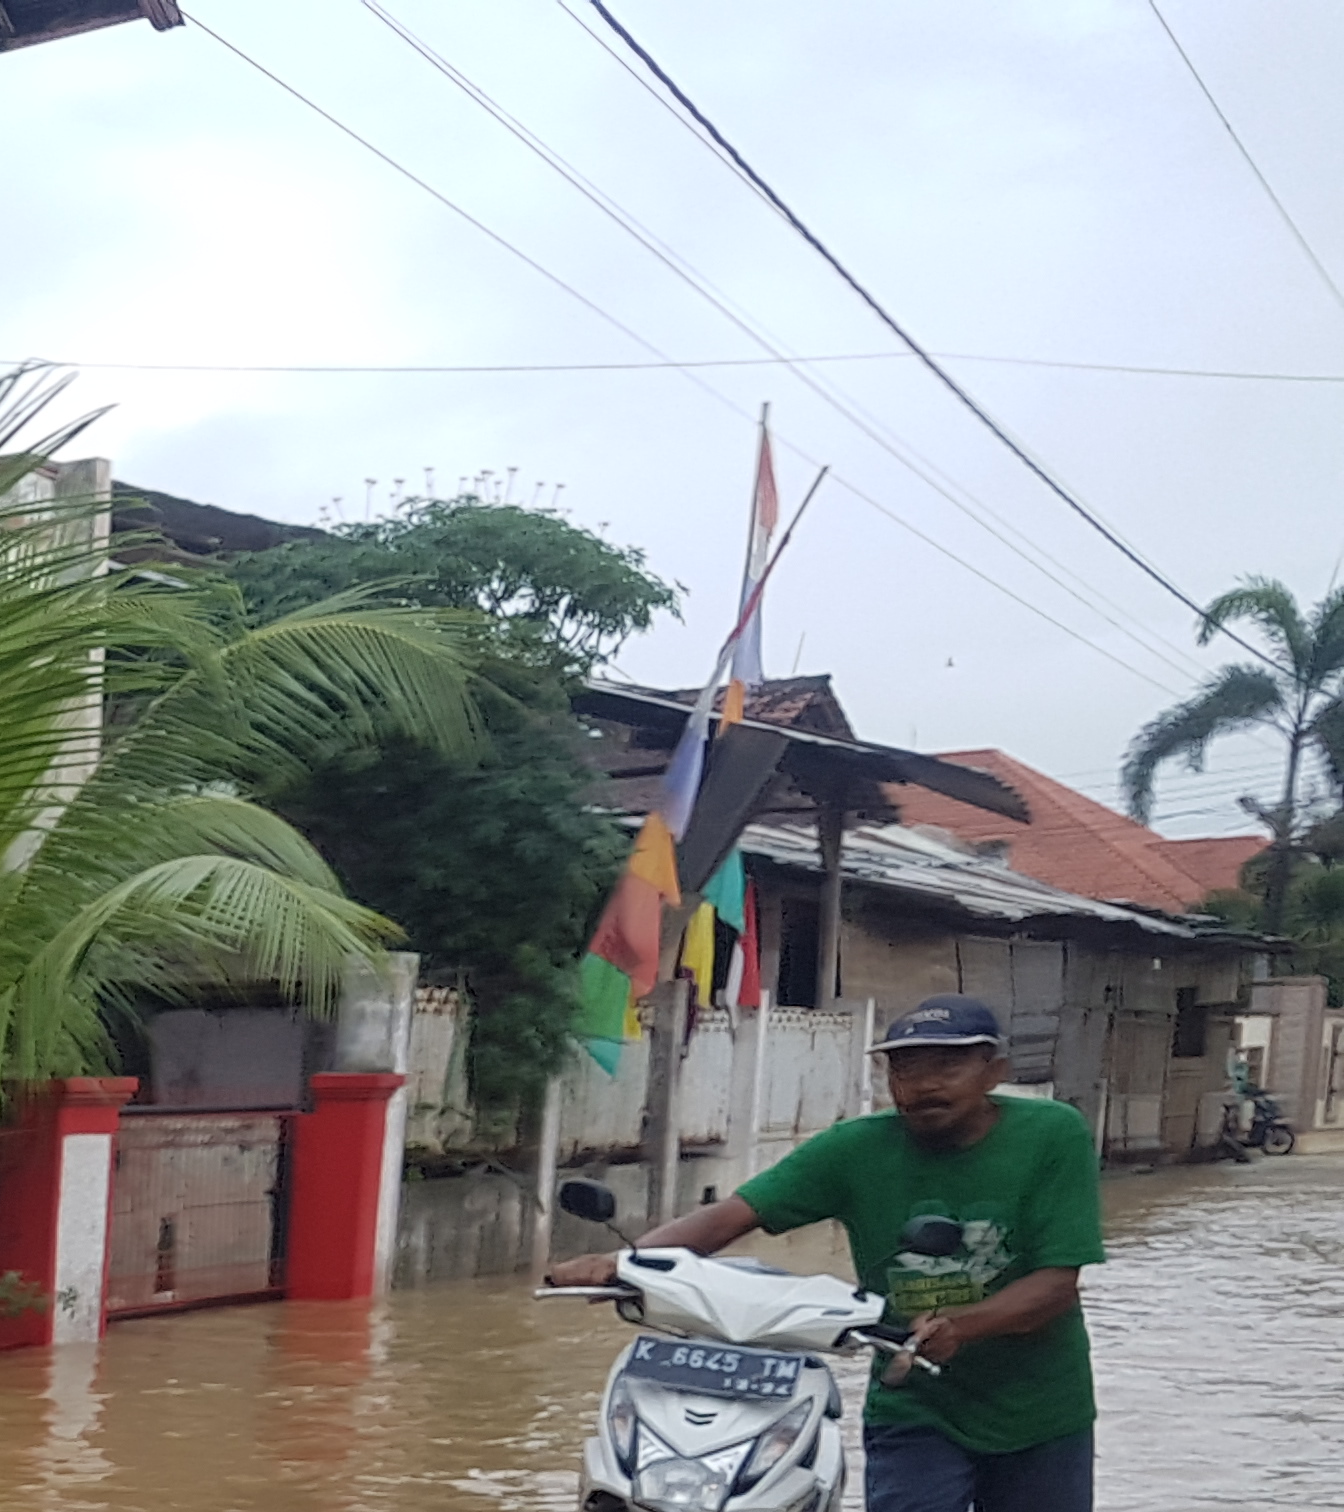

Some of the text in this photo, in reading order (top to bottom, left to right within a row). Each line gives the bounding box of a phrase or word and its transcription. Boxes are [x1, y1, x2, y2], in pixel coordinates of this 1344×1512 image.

[635, 1340, 798, 1379] K 6645 TM
